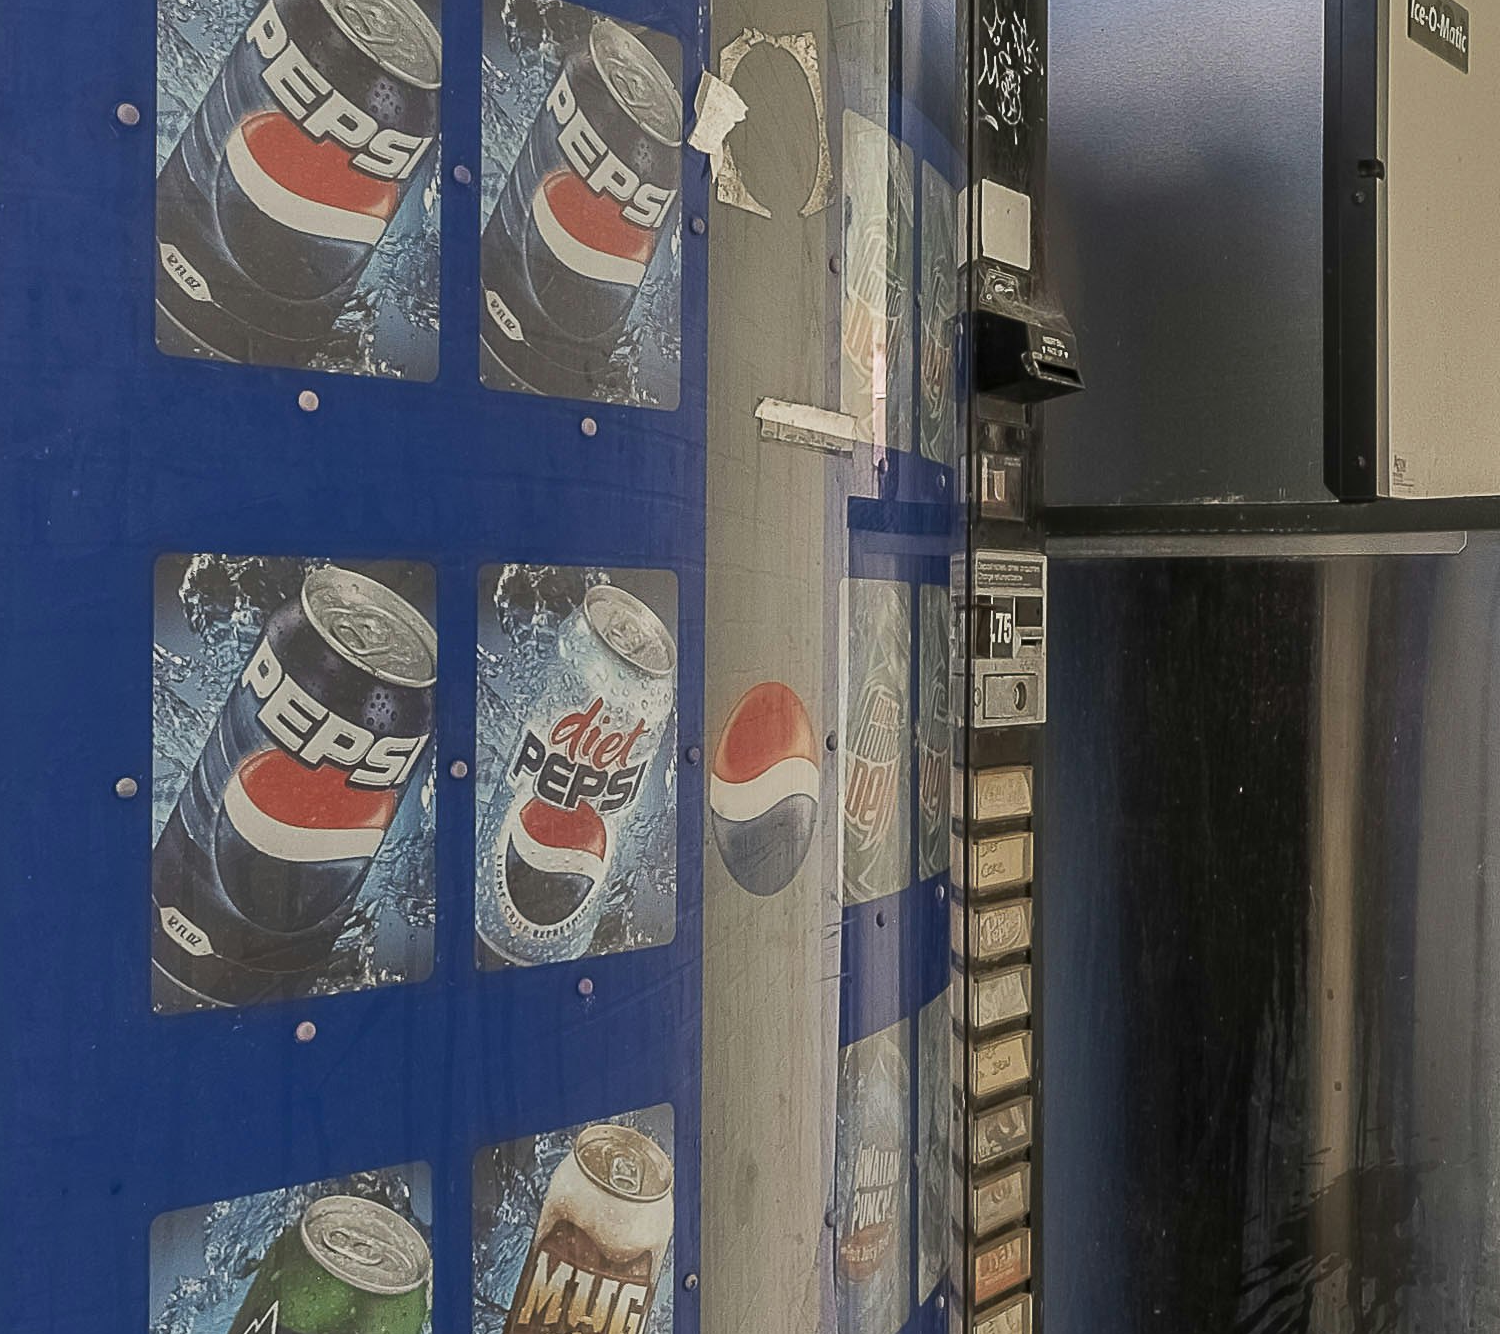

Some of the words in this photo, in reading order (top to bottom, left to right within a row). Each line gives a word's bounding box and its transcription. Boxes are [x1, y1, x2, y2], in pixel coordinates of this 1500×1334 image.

[244, 1, 431, 181] PEPSI
[546, 73, 677, 229] PEPSI
[242, 644, 429, 790] PEPSI
[510, 729, 649, 812] PEPSI
[551, 697, 651, 768] diet
